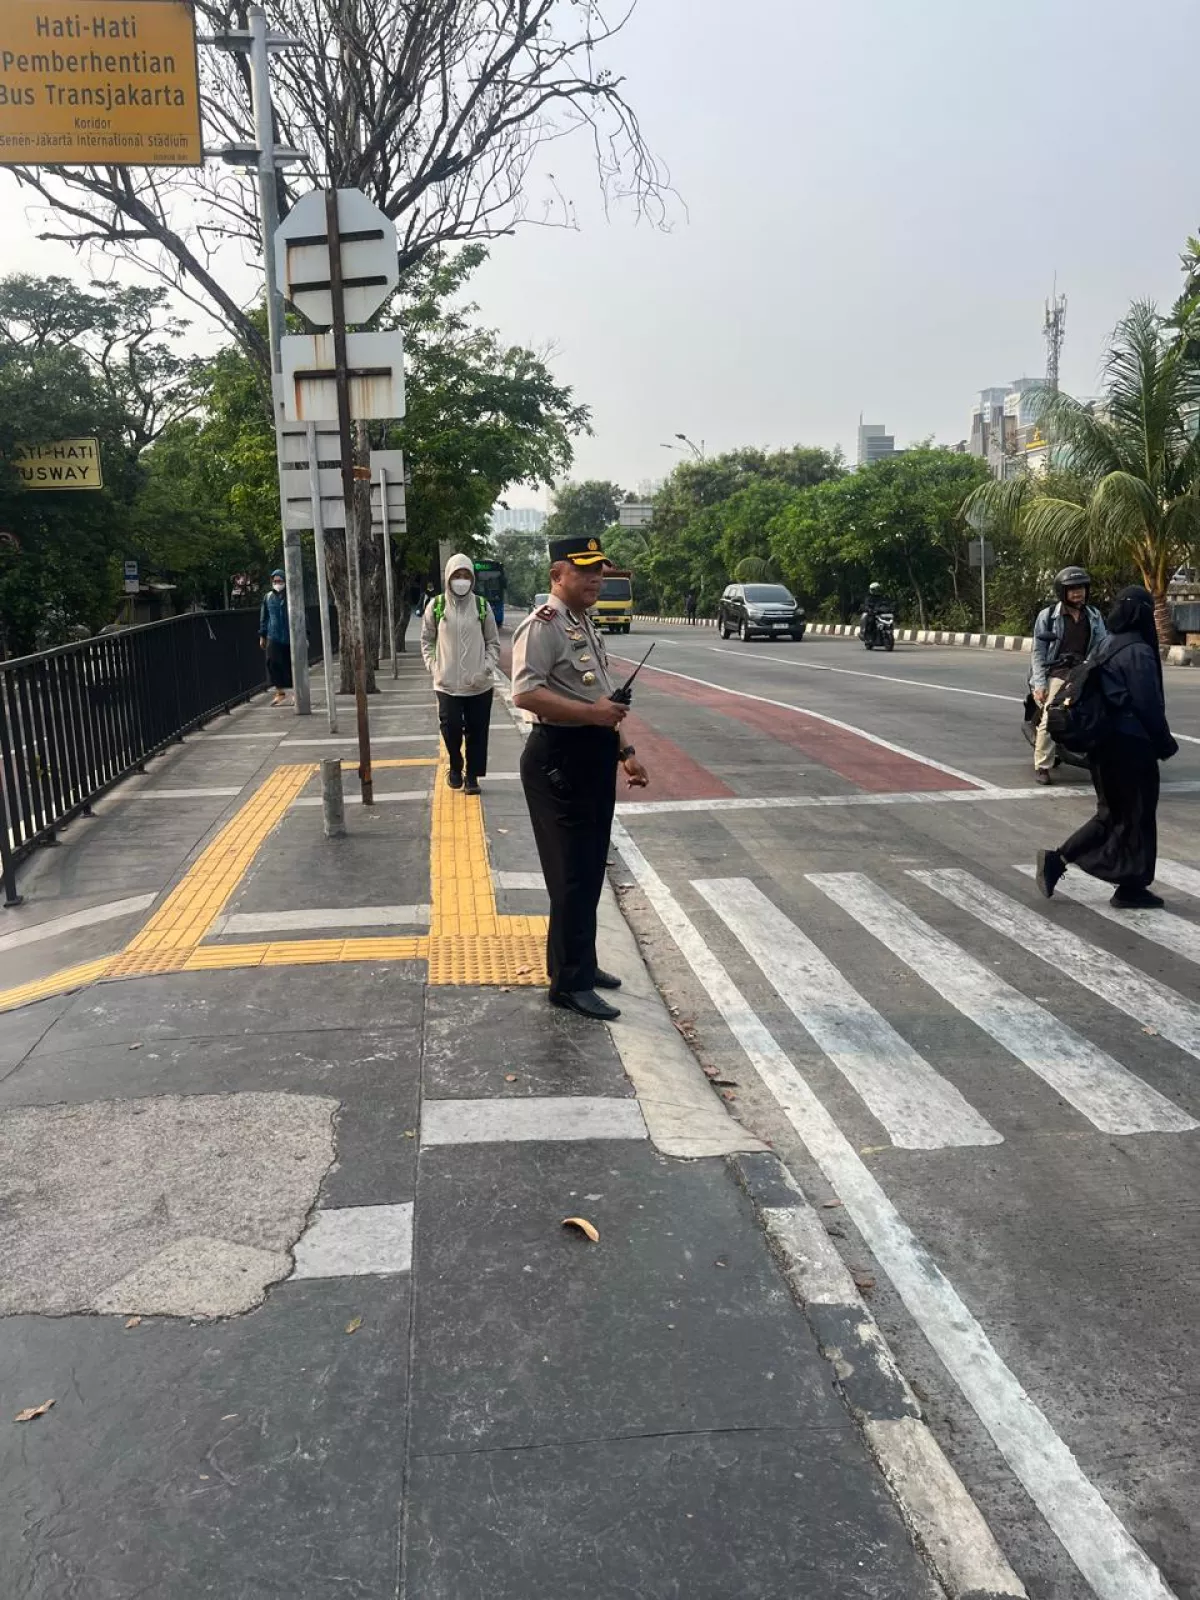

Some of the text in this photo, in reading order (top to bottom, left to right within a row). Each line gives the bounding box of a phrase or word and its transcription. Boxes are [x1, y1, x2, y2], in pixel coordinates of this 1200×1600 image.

[36, 15, 137, 38] Hati-Hati
[3, 50, 175, 72] Pemberhentian
[0, 83, 185, 110] Bus Transjakarta
[74, 117, 111, 129] Koridor
[0, 134, 188, 148] Senen-Jakarta International Stadium
[17, 465, 89, 480] USWAY
